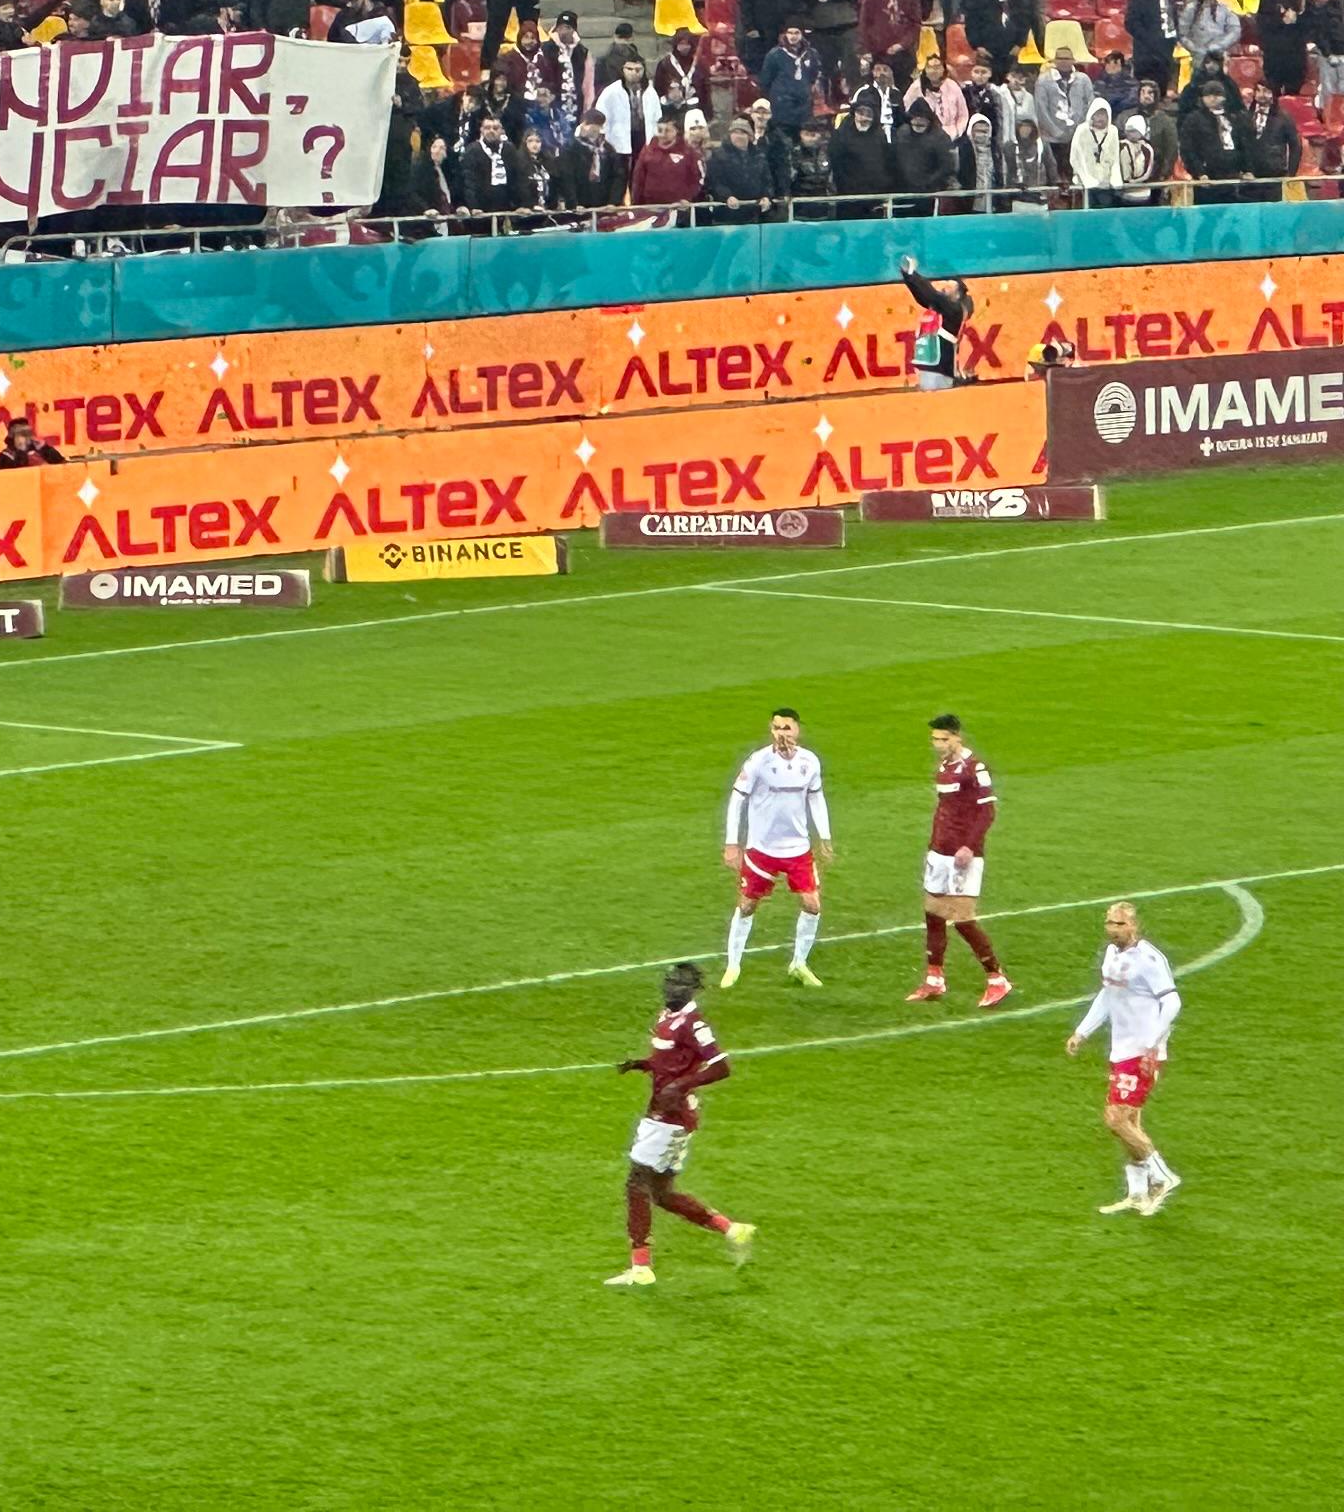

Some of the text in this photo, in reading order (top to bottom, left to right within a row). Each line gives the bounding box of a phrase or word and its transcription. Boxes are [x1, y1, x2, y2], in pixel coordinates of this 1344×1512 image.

[639, 513, 776, 537] CARPATINA
[411, 541, 525, 564] BINANCE
[123, 574, 283, 598] IMAMED
